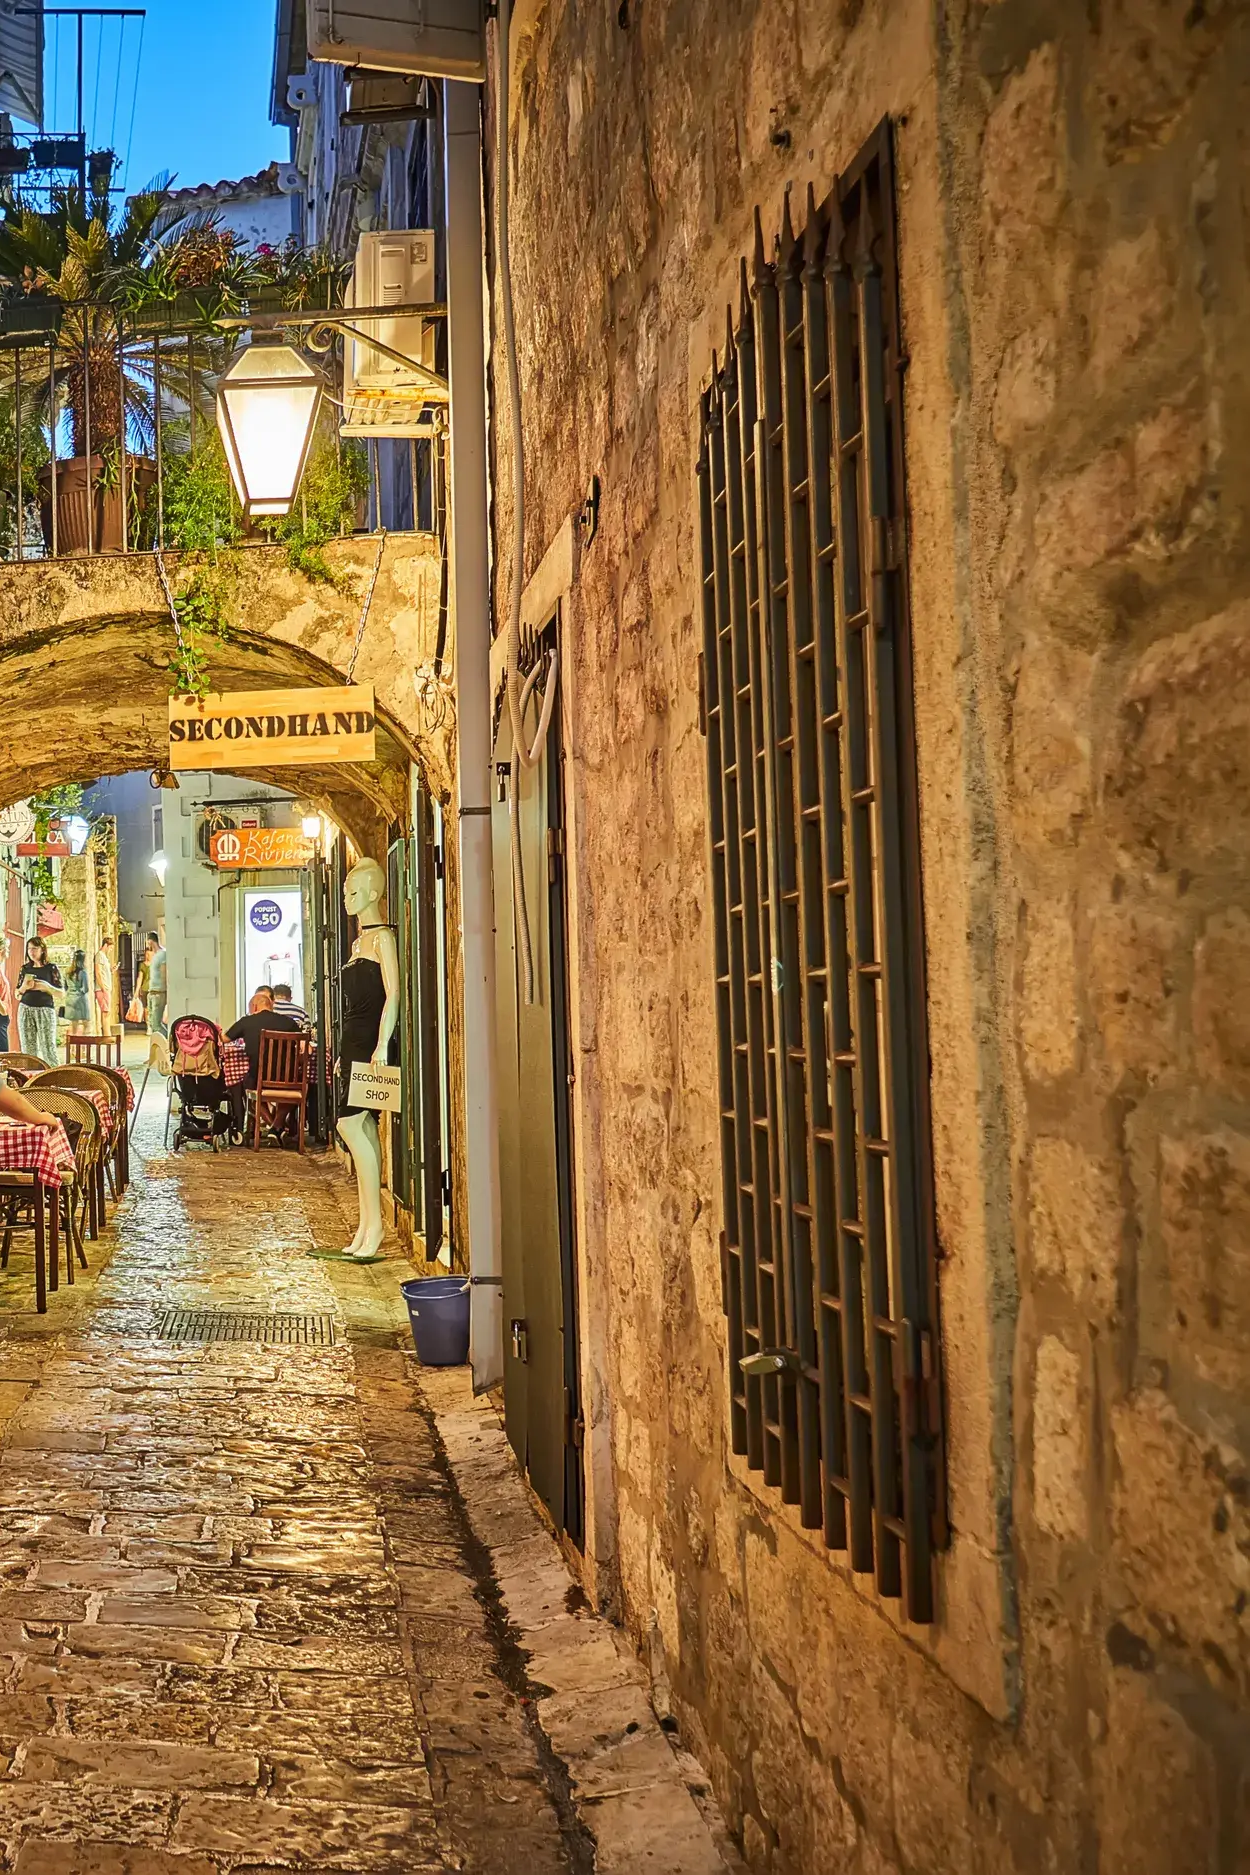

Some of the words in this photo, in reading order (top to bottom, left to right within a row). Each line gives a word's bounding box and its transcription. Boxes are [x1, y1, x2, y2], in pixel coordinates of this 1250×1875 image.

[169, 711, 375, 742] SECONDHAND
[247, 830, 303, 850] Kafana
[252, 913, 279, 926] %50
[352, 1073, 383, 1084] SECOND
[384, 1077, 400, 1086] HAND
[365, 1090, 390, 1101] SHOP
